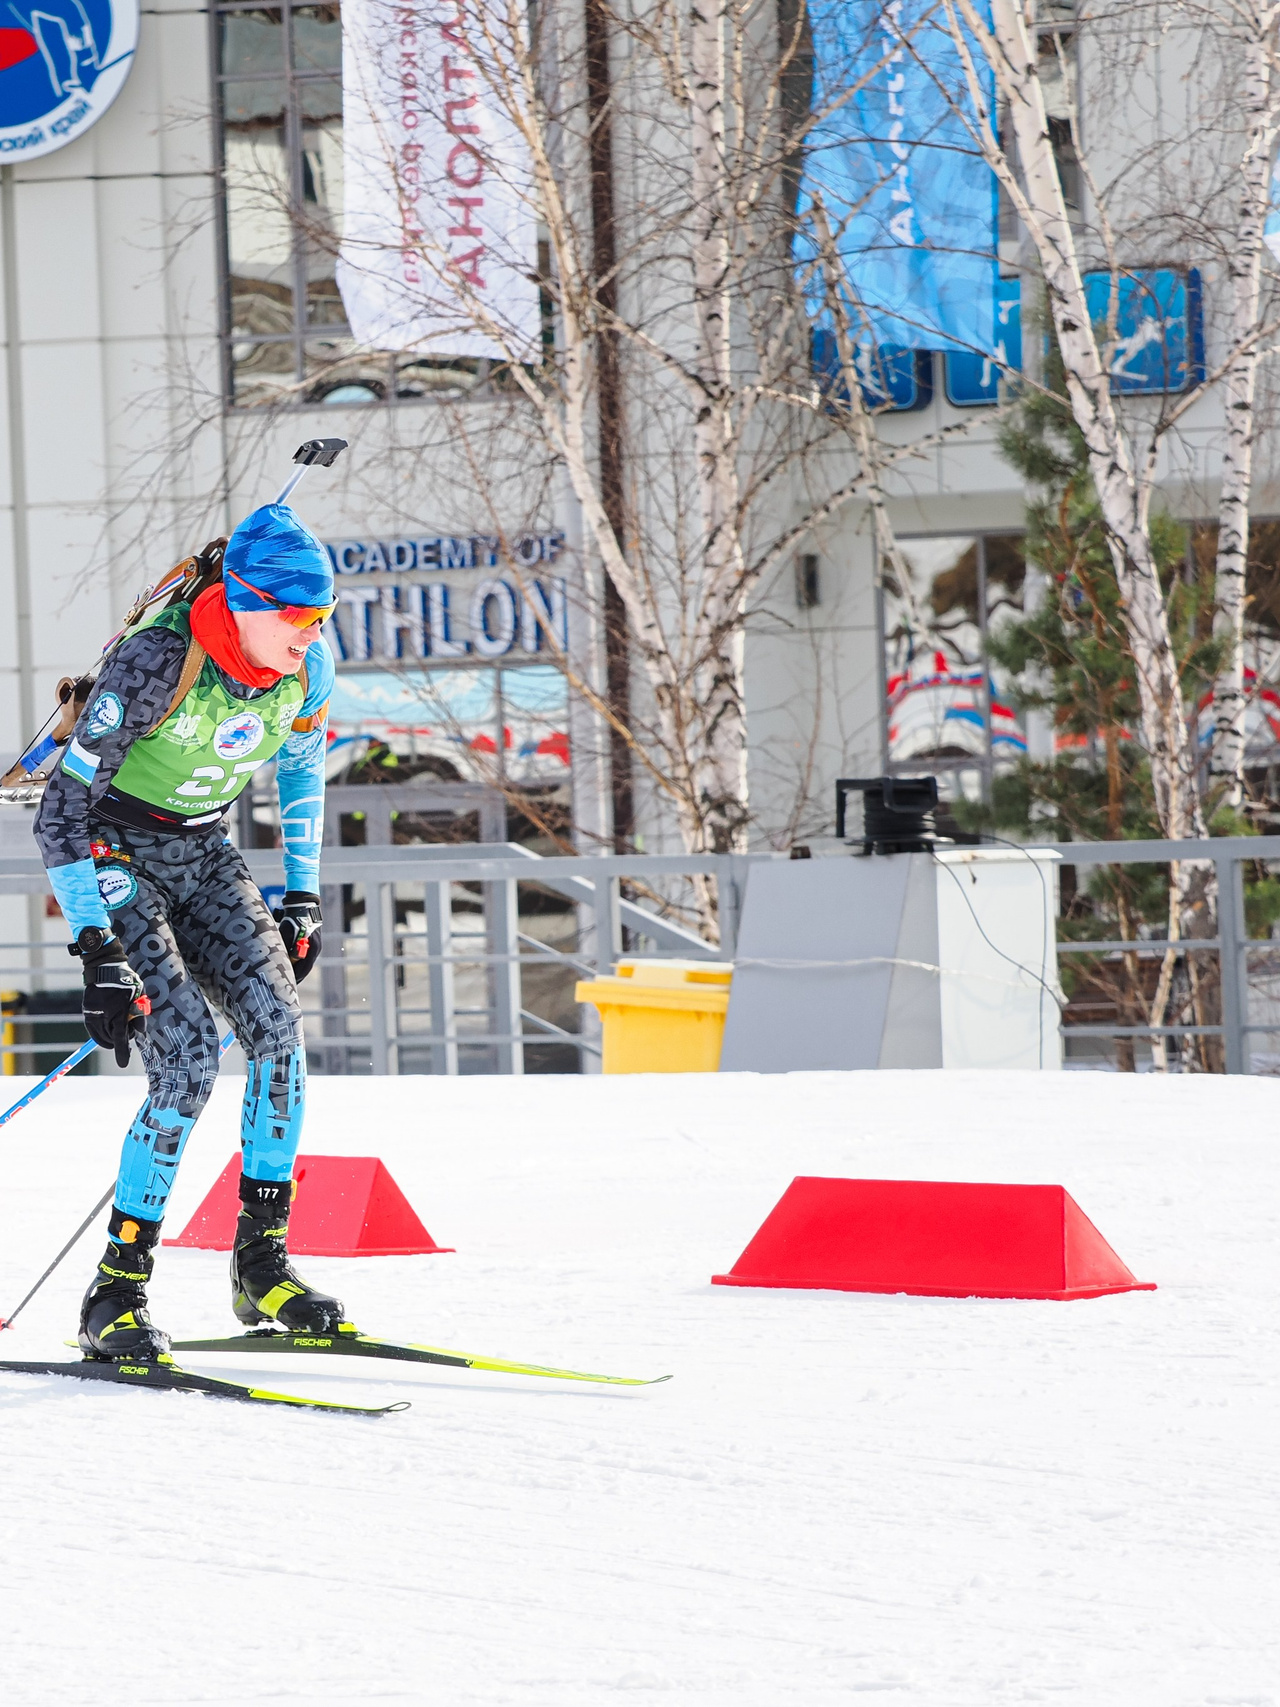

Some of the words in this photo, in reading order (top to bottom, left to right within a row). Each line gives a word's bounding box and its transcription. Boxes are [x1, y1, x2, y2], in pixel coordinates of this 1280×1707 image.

[50, 99, 93, 137] край
[515, 532, 566, 567] OF
[256, 1187, 279, 1199] 177
[99, 1262, 149, 1281] FISCHER
[294, 1338, 332, 1348] FISCHER
[118, 1365, 149, 1376] FISCHER
